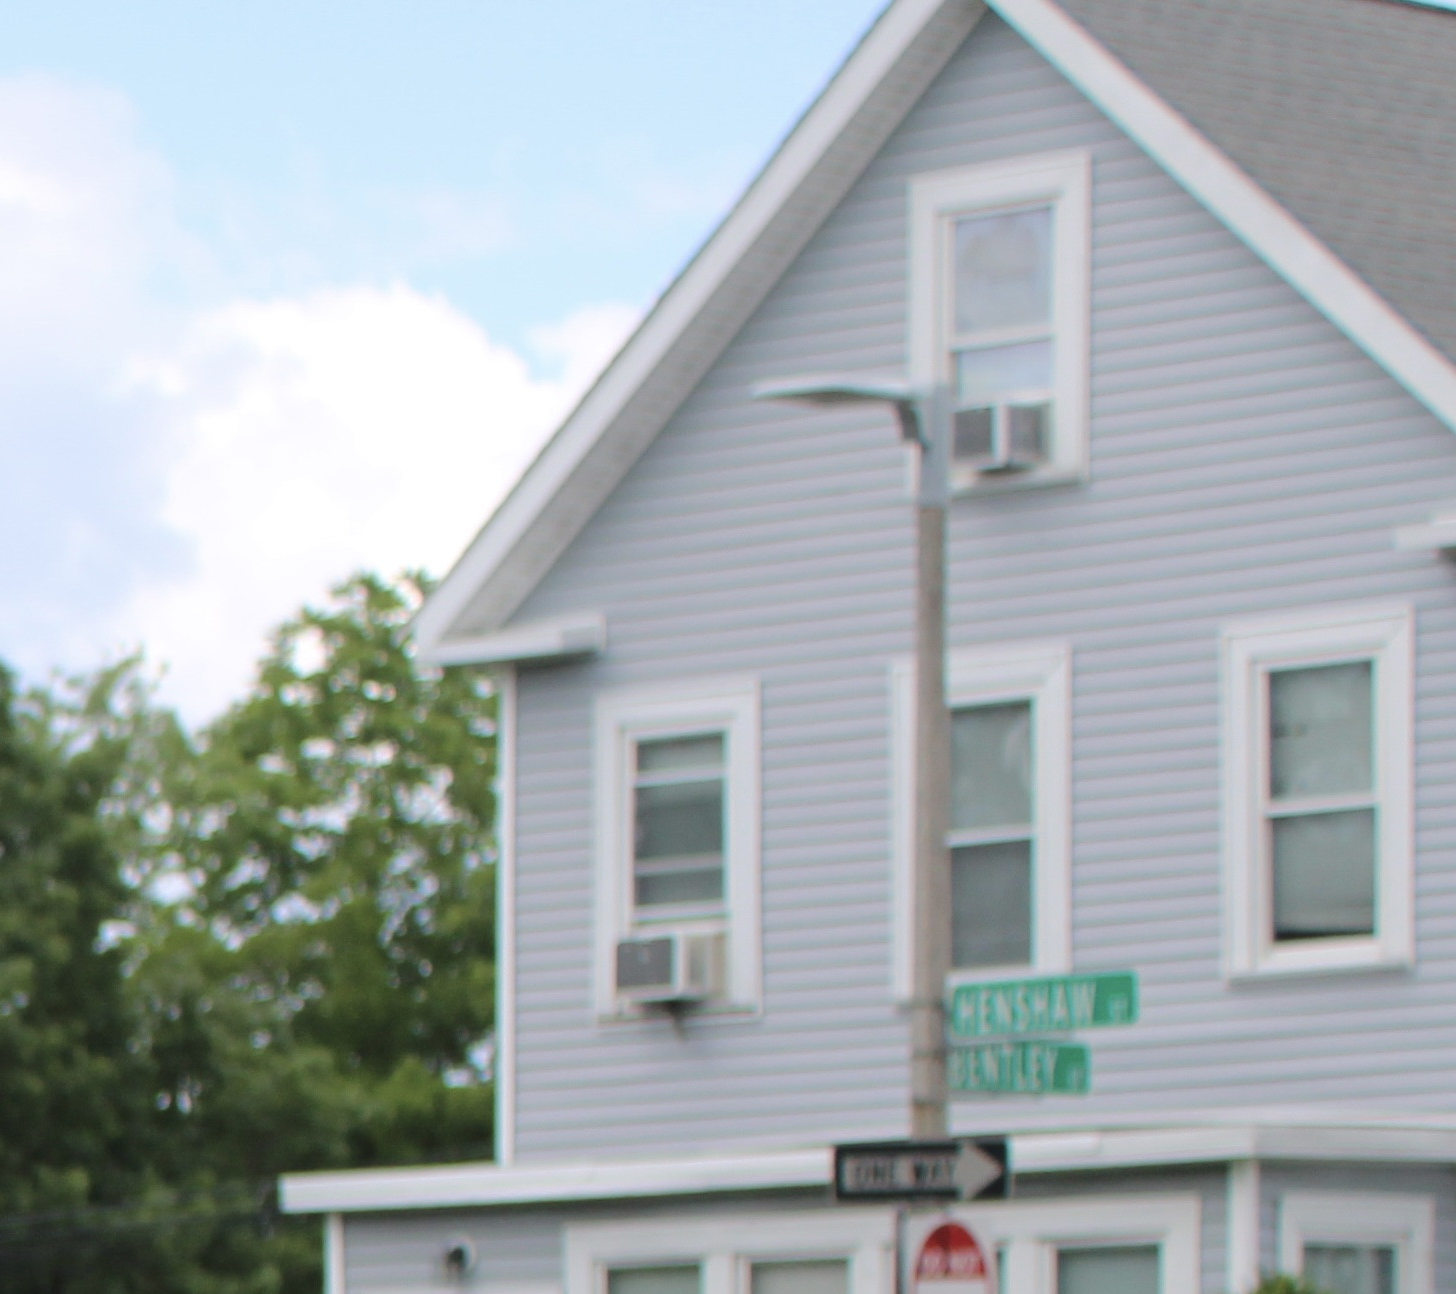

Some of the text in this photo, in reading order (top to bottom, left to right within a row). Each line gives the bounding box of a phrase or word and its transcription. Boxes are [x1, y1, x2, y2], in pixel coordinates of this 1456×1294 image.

[959, 982, 1097, 1034] HENSHAW
[852, 1156, 955, 1190] ONE WAY
